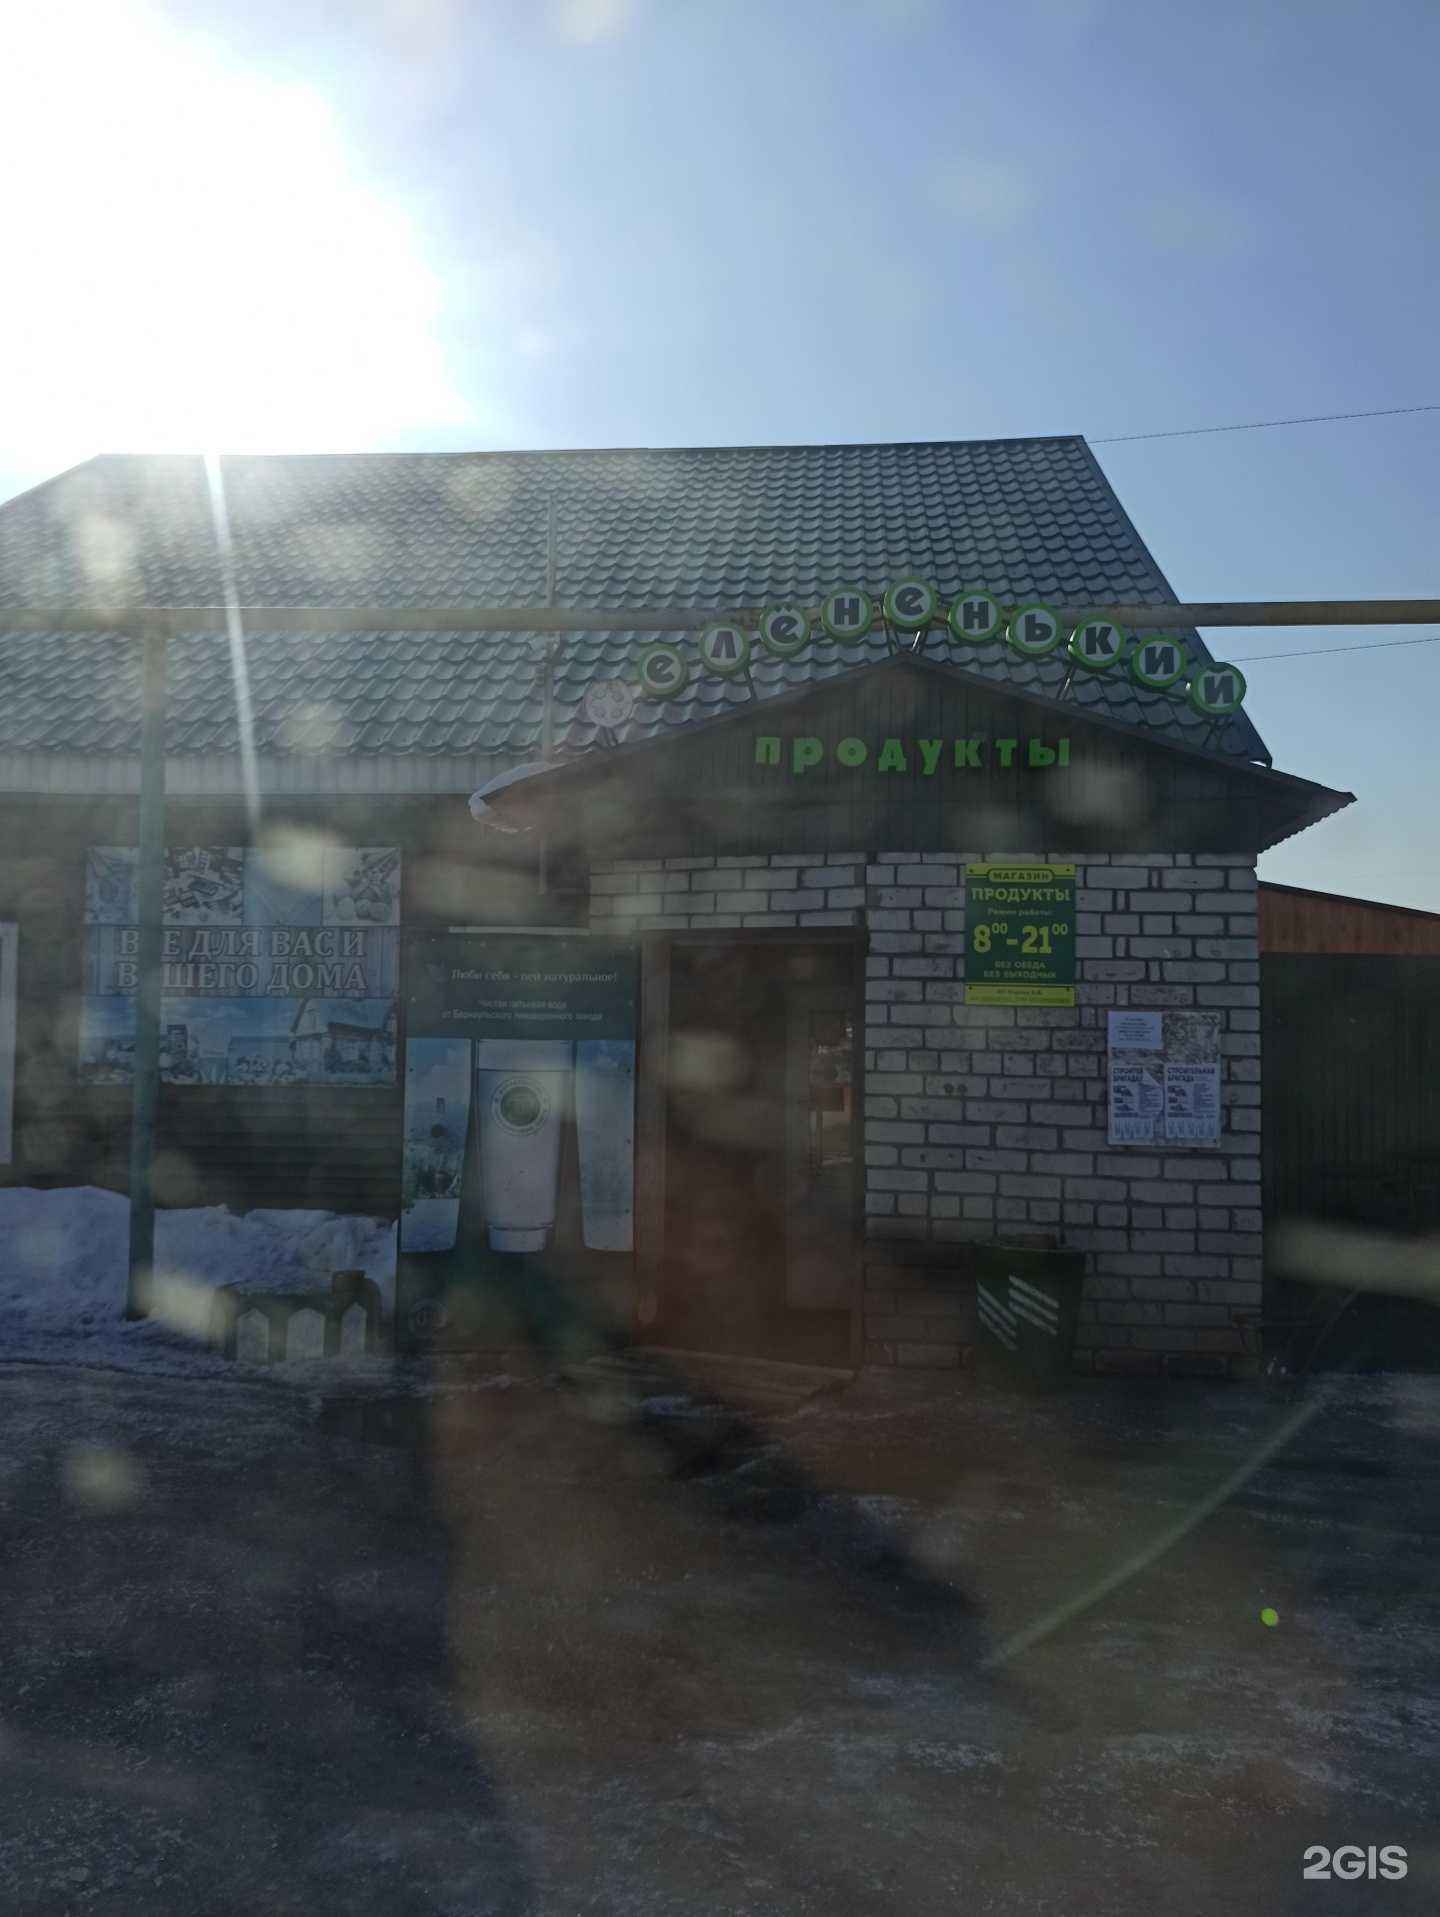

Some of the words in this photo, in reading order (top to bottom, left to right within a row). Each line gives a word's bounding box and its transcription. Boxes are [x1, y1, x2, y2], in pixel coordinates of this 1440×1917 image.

[992, 870, 1049, 881] МАГАЗИН
[972, 888, 1070, 902] ПРОДУКТЫ
[119, 929, 181, 957] ВЕ
[188, 929, 263, 960] ДЛЯ
[270, 930, 334, 957] ВАС
[342, 930, 366, 957] И
[115, 961, 259, 989] ВШЕГО
[265, 962, 368, 992] ДОМА
